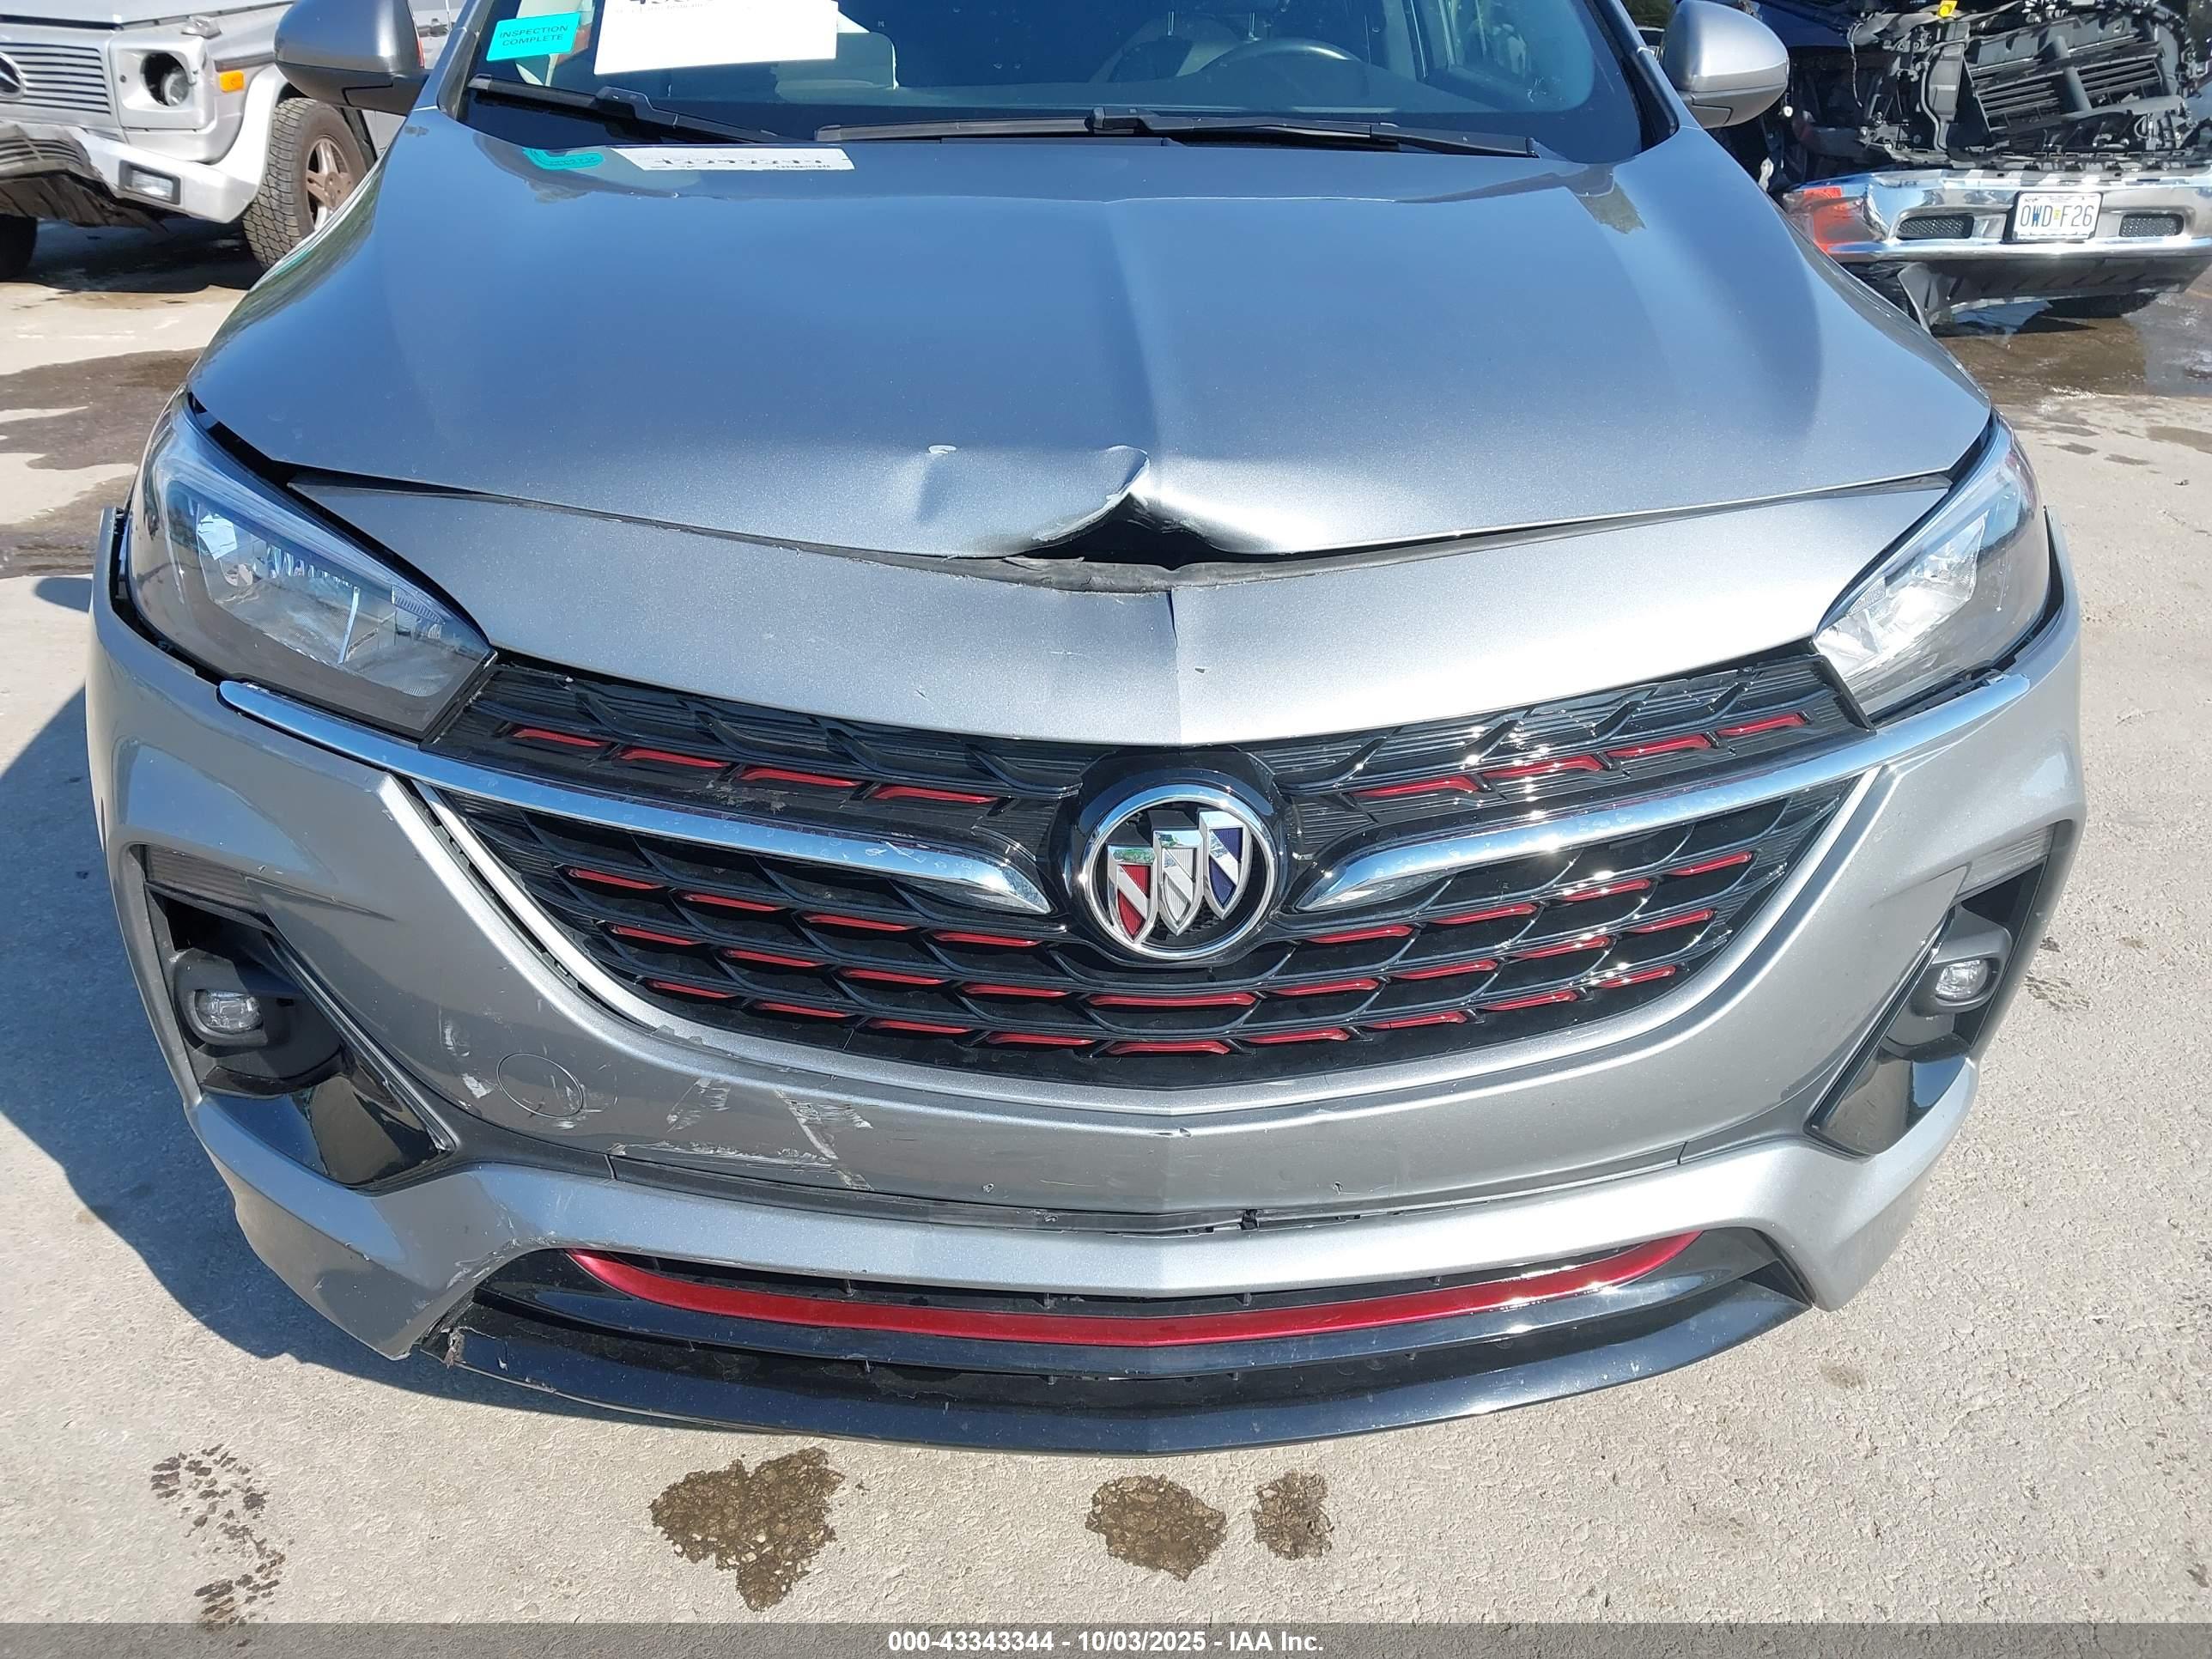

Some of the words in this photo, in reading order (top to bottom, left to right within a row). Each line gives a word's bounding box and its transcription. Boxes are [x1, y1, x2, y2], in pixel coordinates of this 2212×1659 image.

[499, 25, 568, 39] INSPECTION
[501, 33, 563, 46] COMPLETE
[2060, 205, 2094, 228] F26
